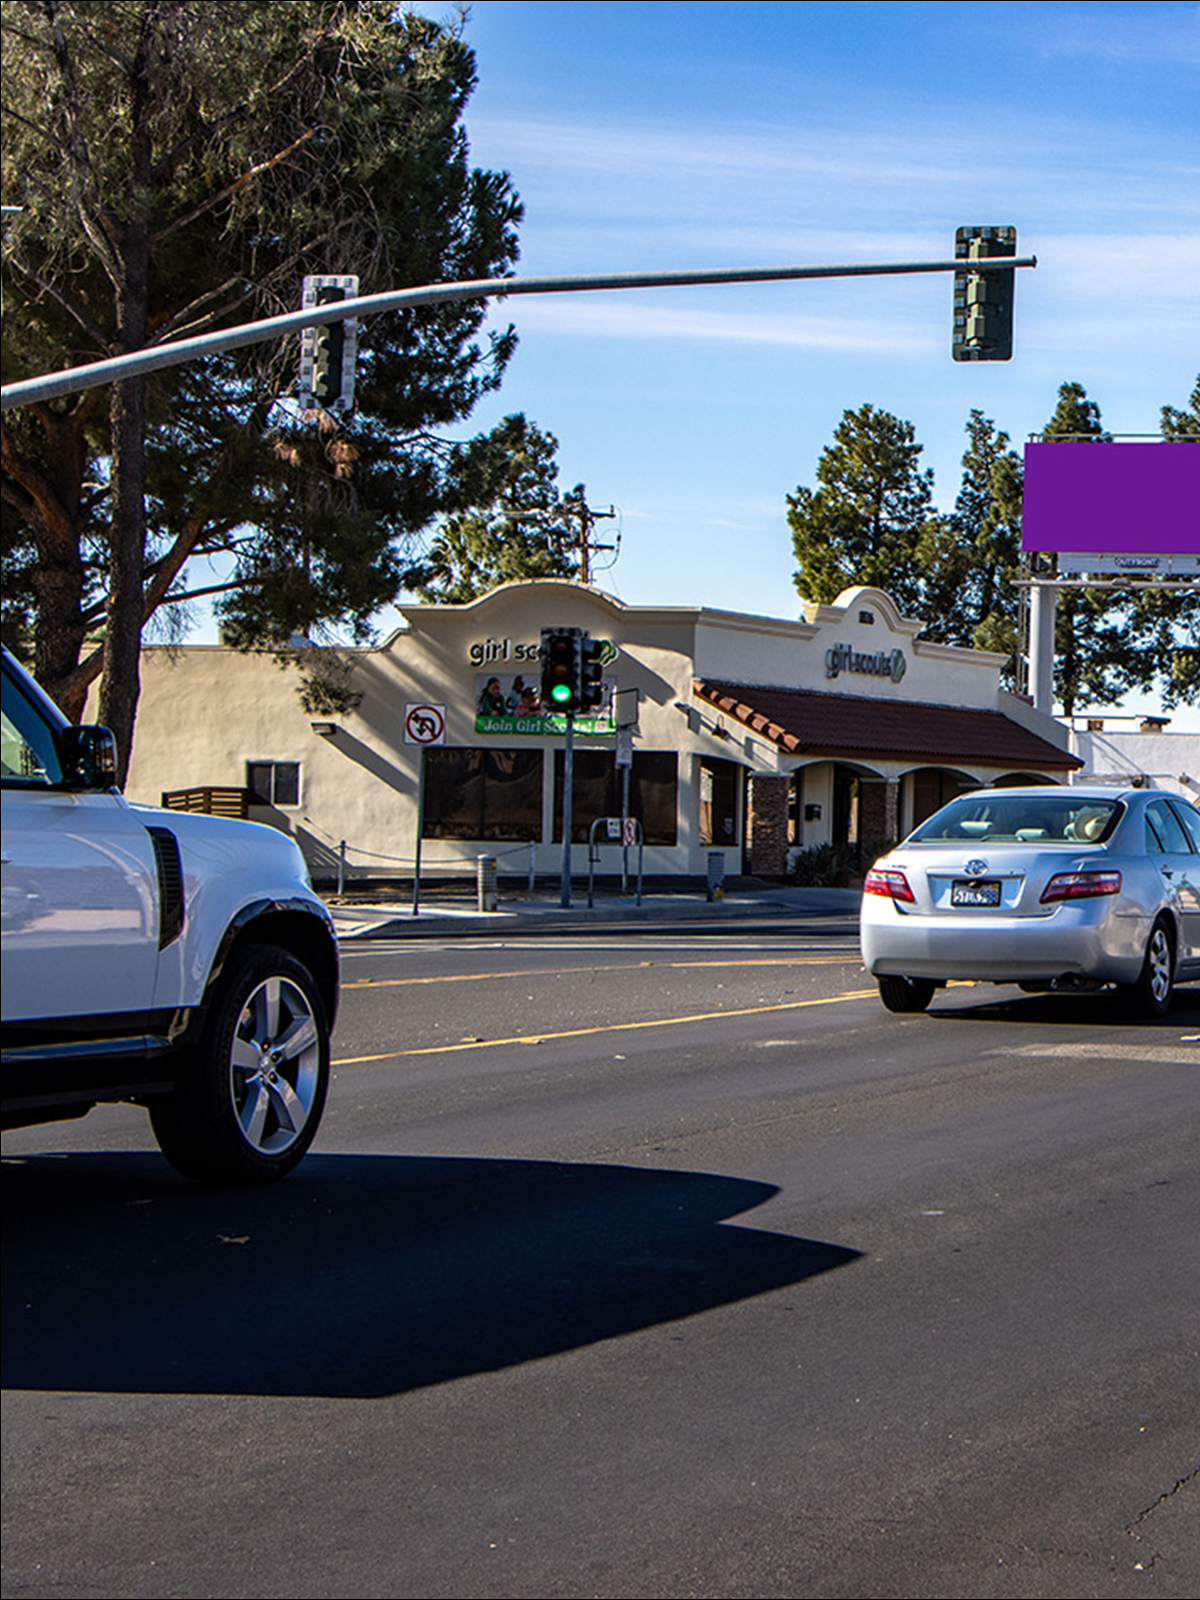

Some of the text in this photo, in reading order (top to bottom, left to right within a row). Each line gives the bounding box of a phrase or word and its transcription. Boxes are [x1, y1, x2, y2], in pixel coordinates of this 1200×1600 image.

[1115, 556, 1158, 567] OUTFRONT
[470, 638, 511, 667] girl
[484, 720, 513, 731] Join
[516, 719, 541, 731] Girl
